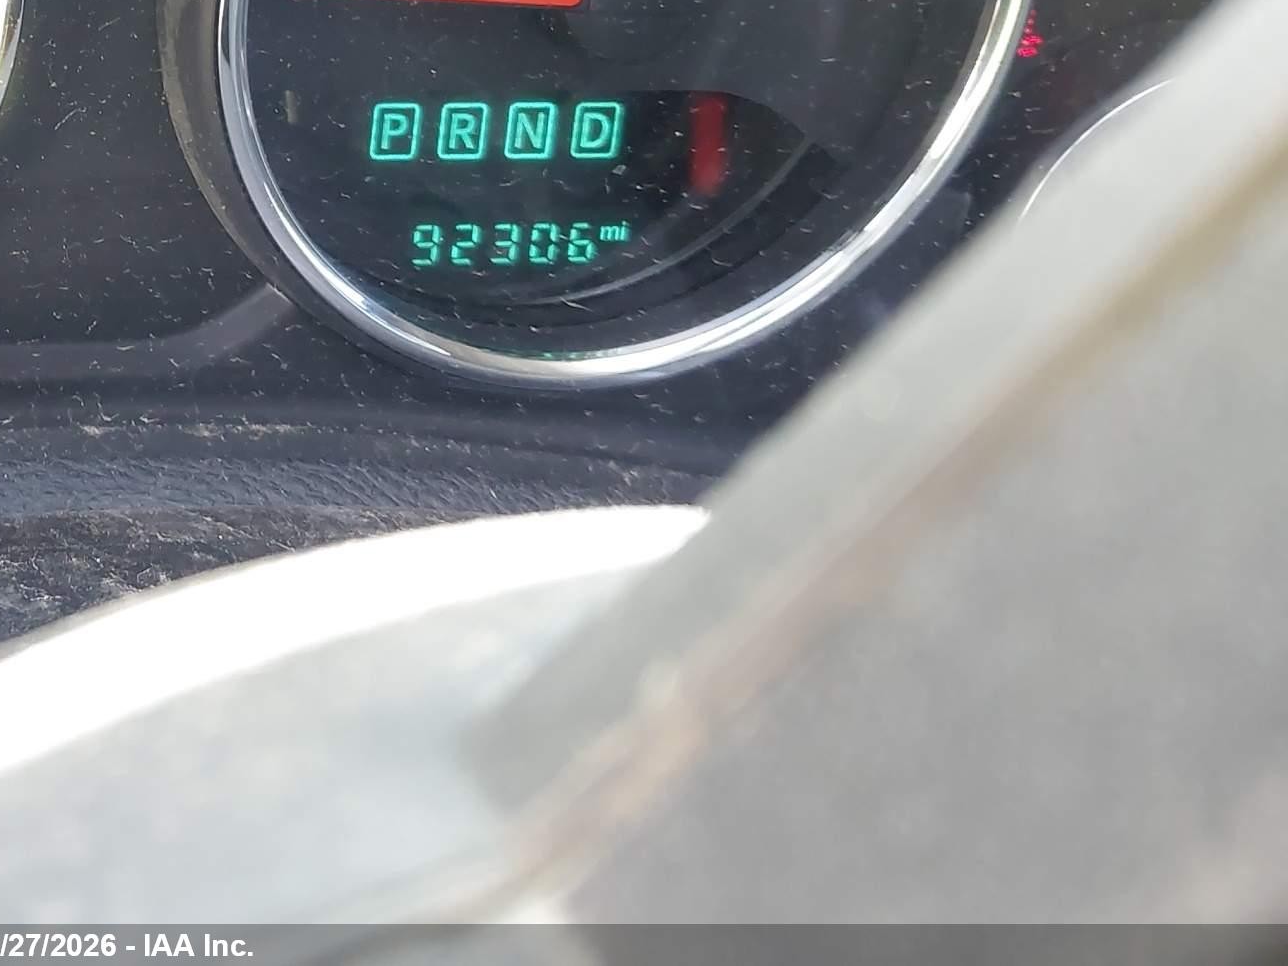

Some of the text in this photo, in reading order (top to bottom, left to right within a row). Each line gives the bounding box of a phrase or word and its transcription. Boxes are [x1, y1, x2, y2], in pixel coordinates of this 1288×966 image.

[381, 113, 610, 150] P R N D
[412, 220, 630, 266] 92306 mi
